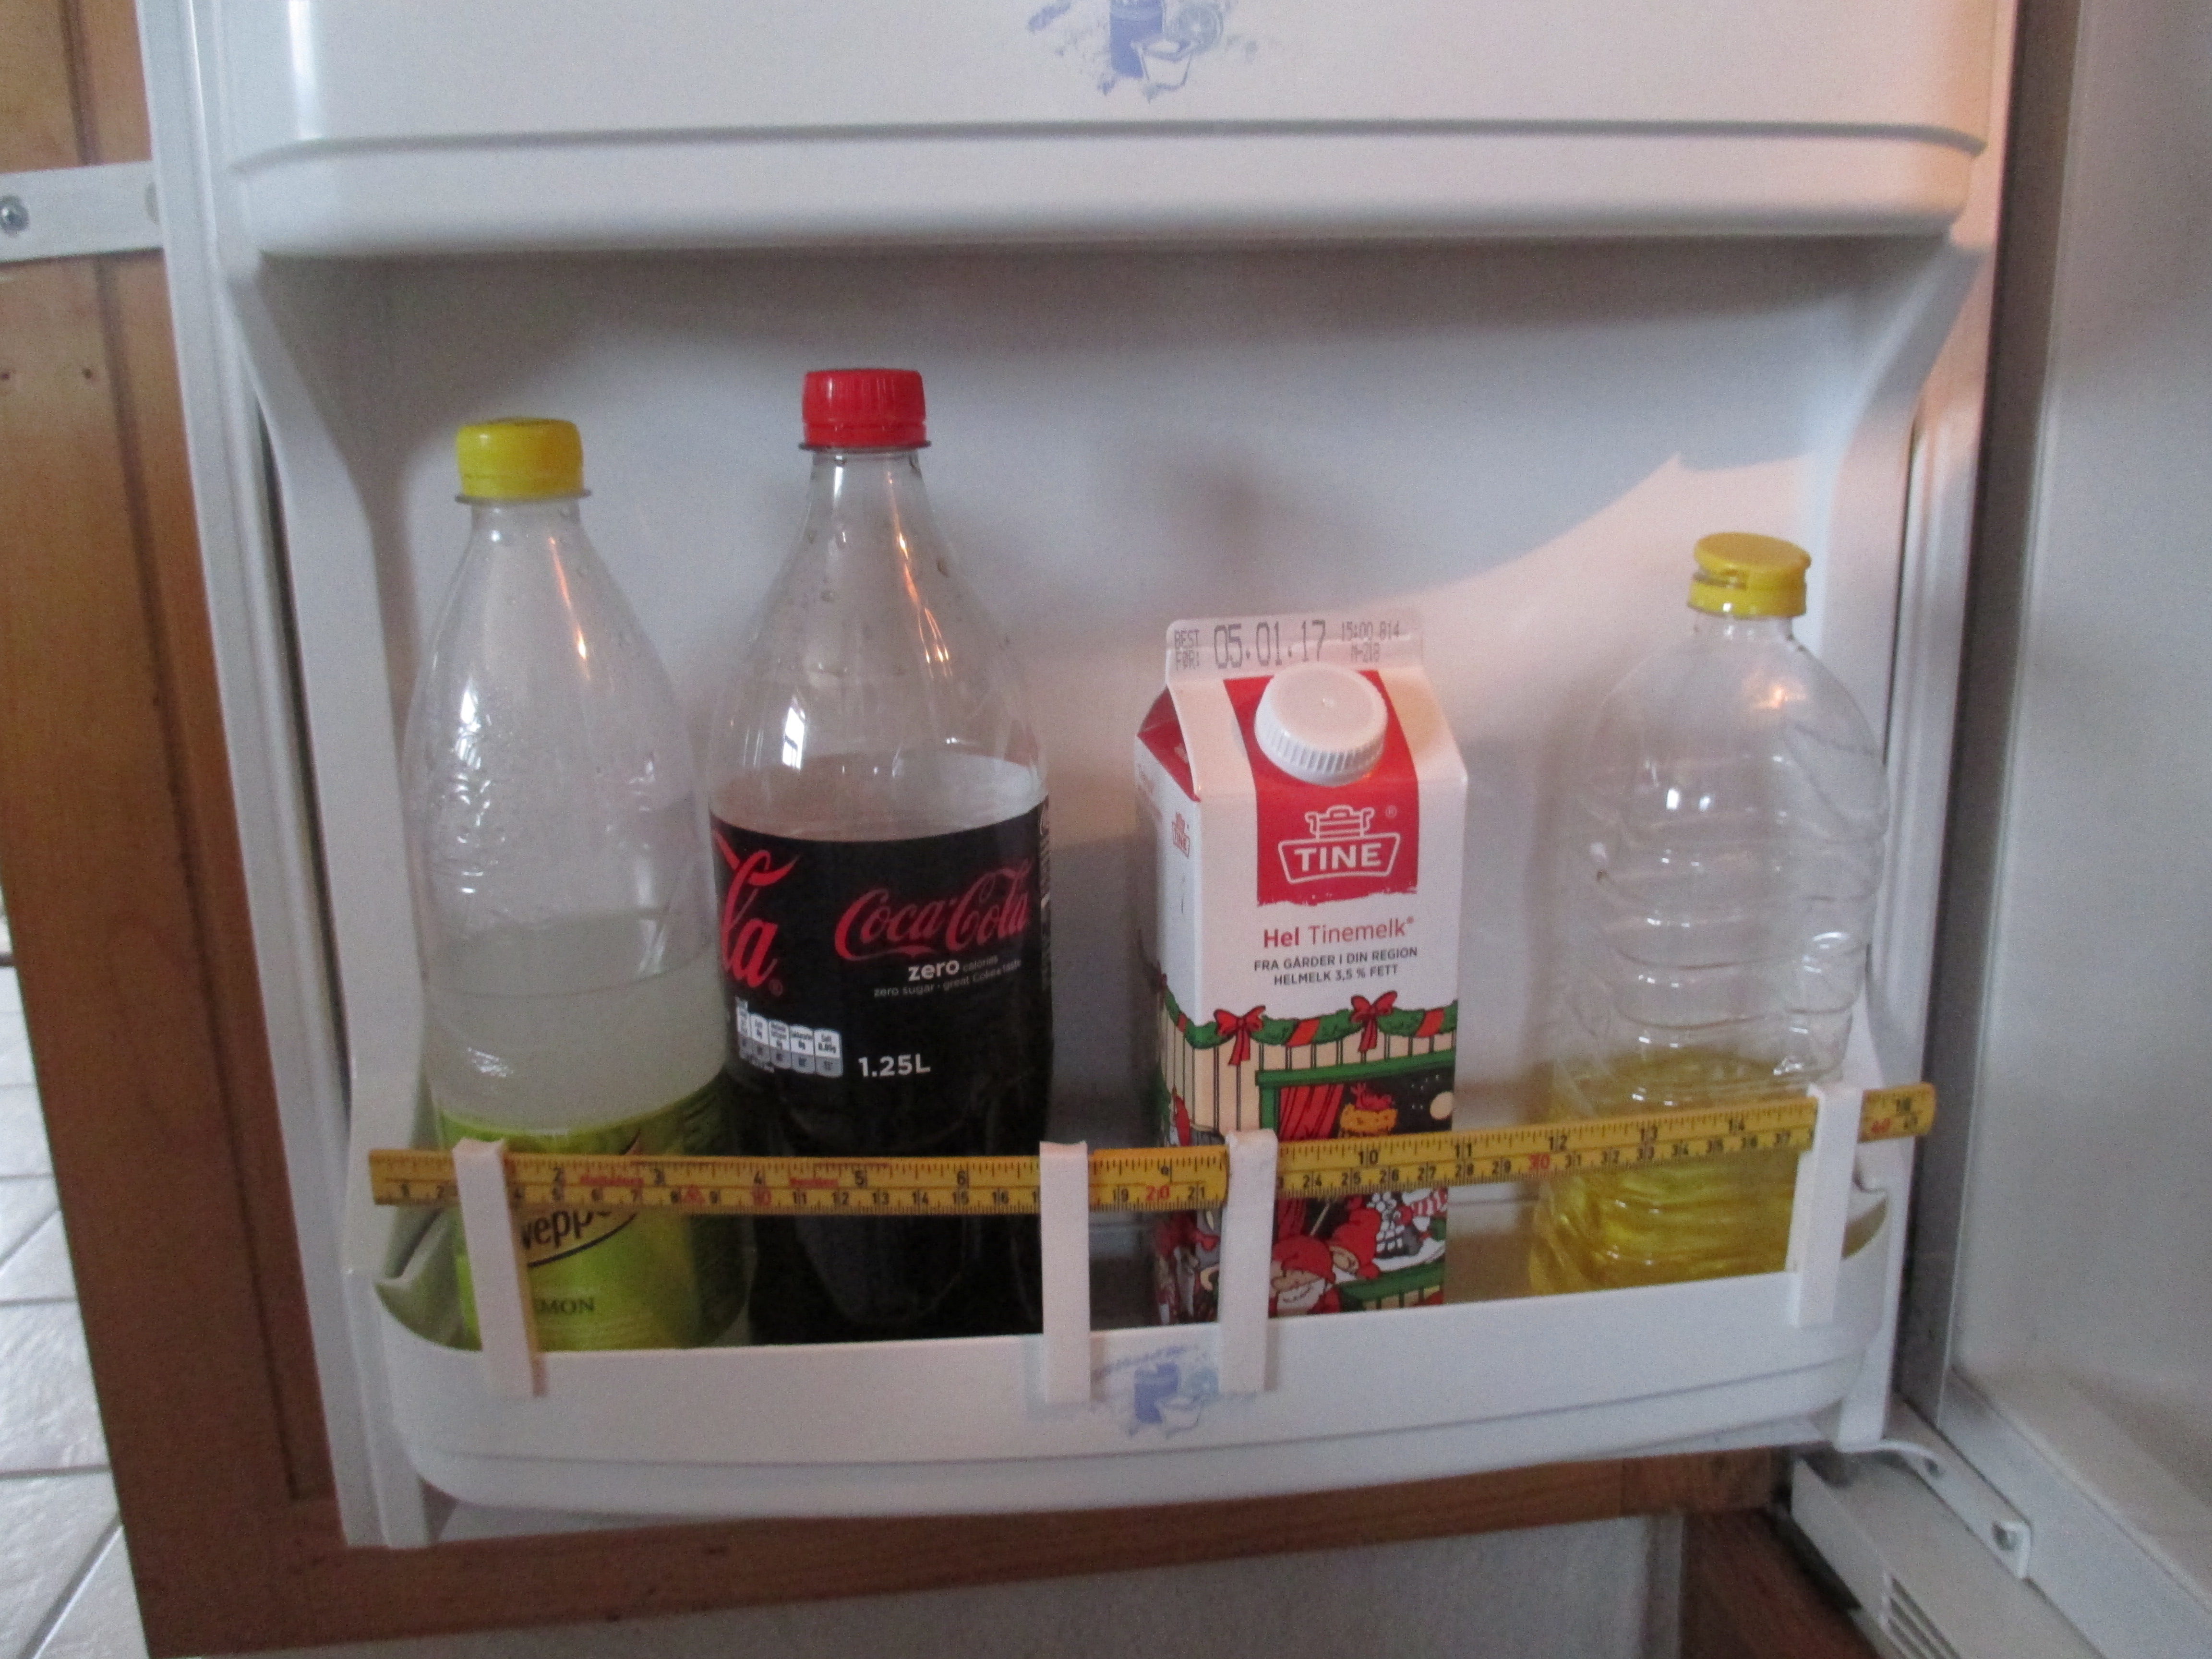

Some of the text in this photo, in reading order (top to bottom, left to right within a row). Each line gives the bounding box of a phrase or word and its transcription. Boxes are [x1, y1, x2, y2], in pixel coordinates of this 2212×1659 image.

[1174, 629, 1200, 648] BEST
[1294, 842, 1383, 873] TINE
[1263, 926, 1300, 949] Hel
[908, 959, 960, 982] zero
[1254, 960, 1279, 972] FRA
[1339, 953, 1343, 965] I
[1346, 951, 1368, 964] DIN
[1372, 946, 1418, 961] REGION
[1274, 970, 1331, 986] HELMELK
[1370, 963, 1398, 977] FETT
[874, 986, 900, 998] zero
[902, 983, 936, 996] sugar
[858, 1053, 931, 1077] 1.25L
[1358, 1149, 1379, 1165] 10
[1455, 1142, 1472, 1158] 11
[1549, 1134, 1568, 1151] 12
[1145, 1185, 1170, 1201] 20
[1187, 1186, 1205, 1201] 21
[1302, 1174, 1322, 1188] 24
[1417, 1165, 1437, 1181] 27
[1455, 1162, 1474, 1178] 28
[534, 1297, 595, 1315] MON
